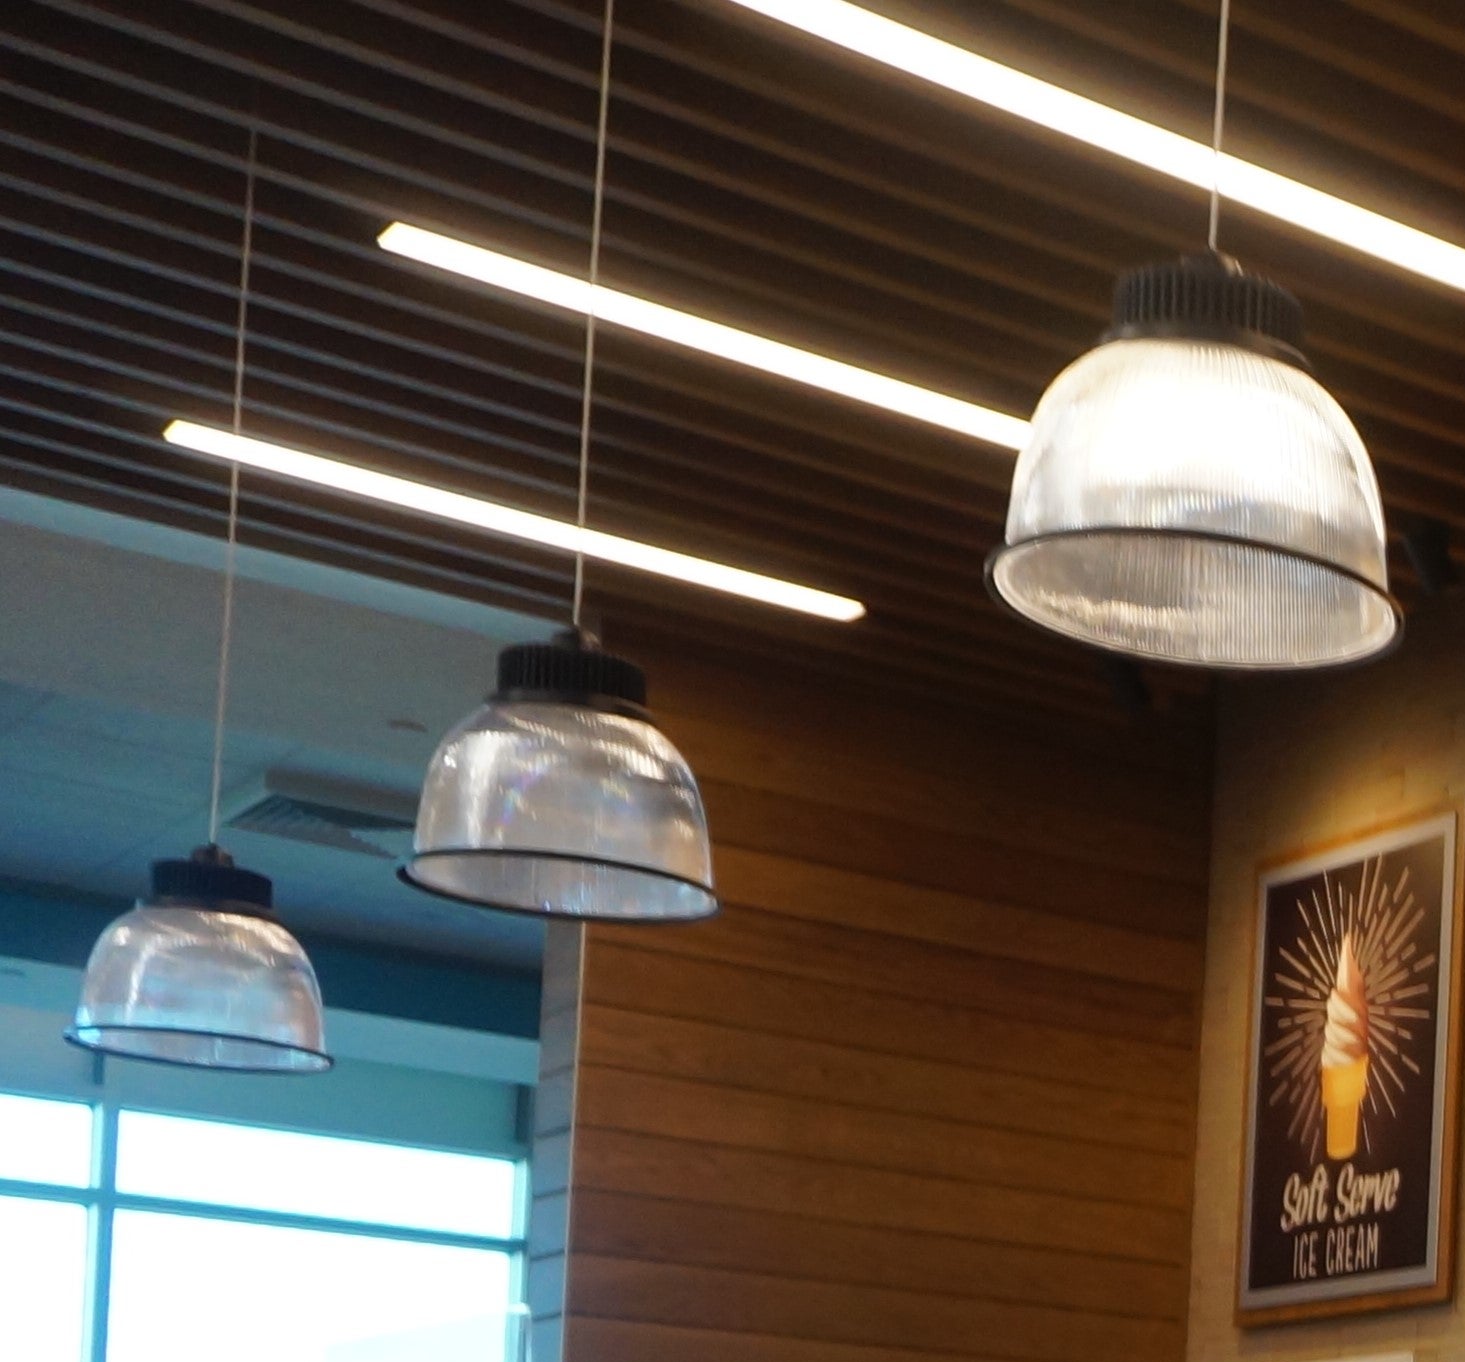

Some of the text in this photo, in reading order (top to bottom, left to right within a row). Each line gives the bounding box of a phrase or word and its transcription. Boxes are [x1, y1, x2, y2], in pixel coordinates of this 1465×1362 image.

[1280, 1161, 1401, 1233] Soft Serve
[1291, 1222, 1380, 1279] ICE CREAM
